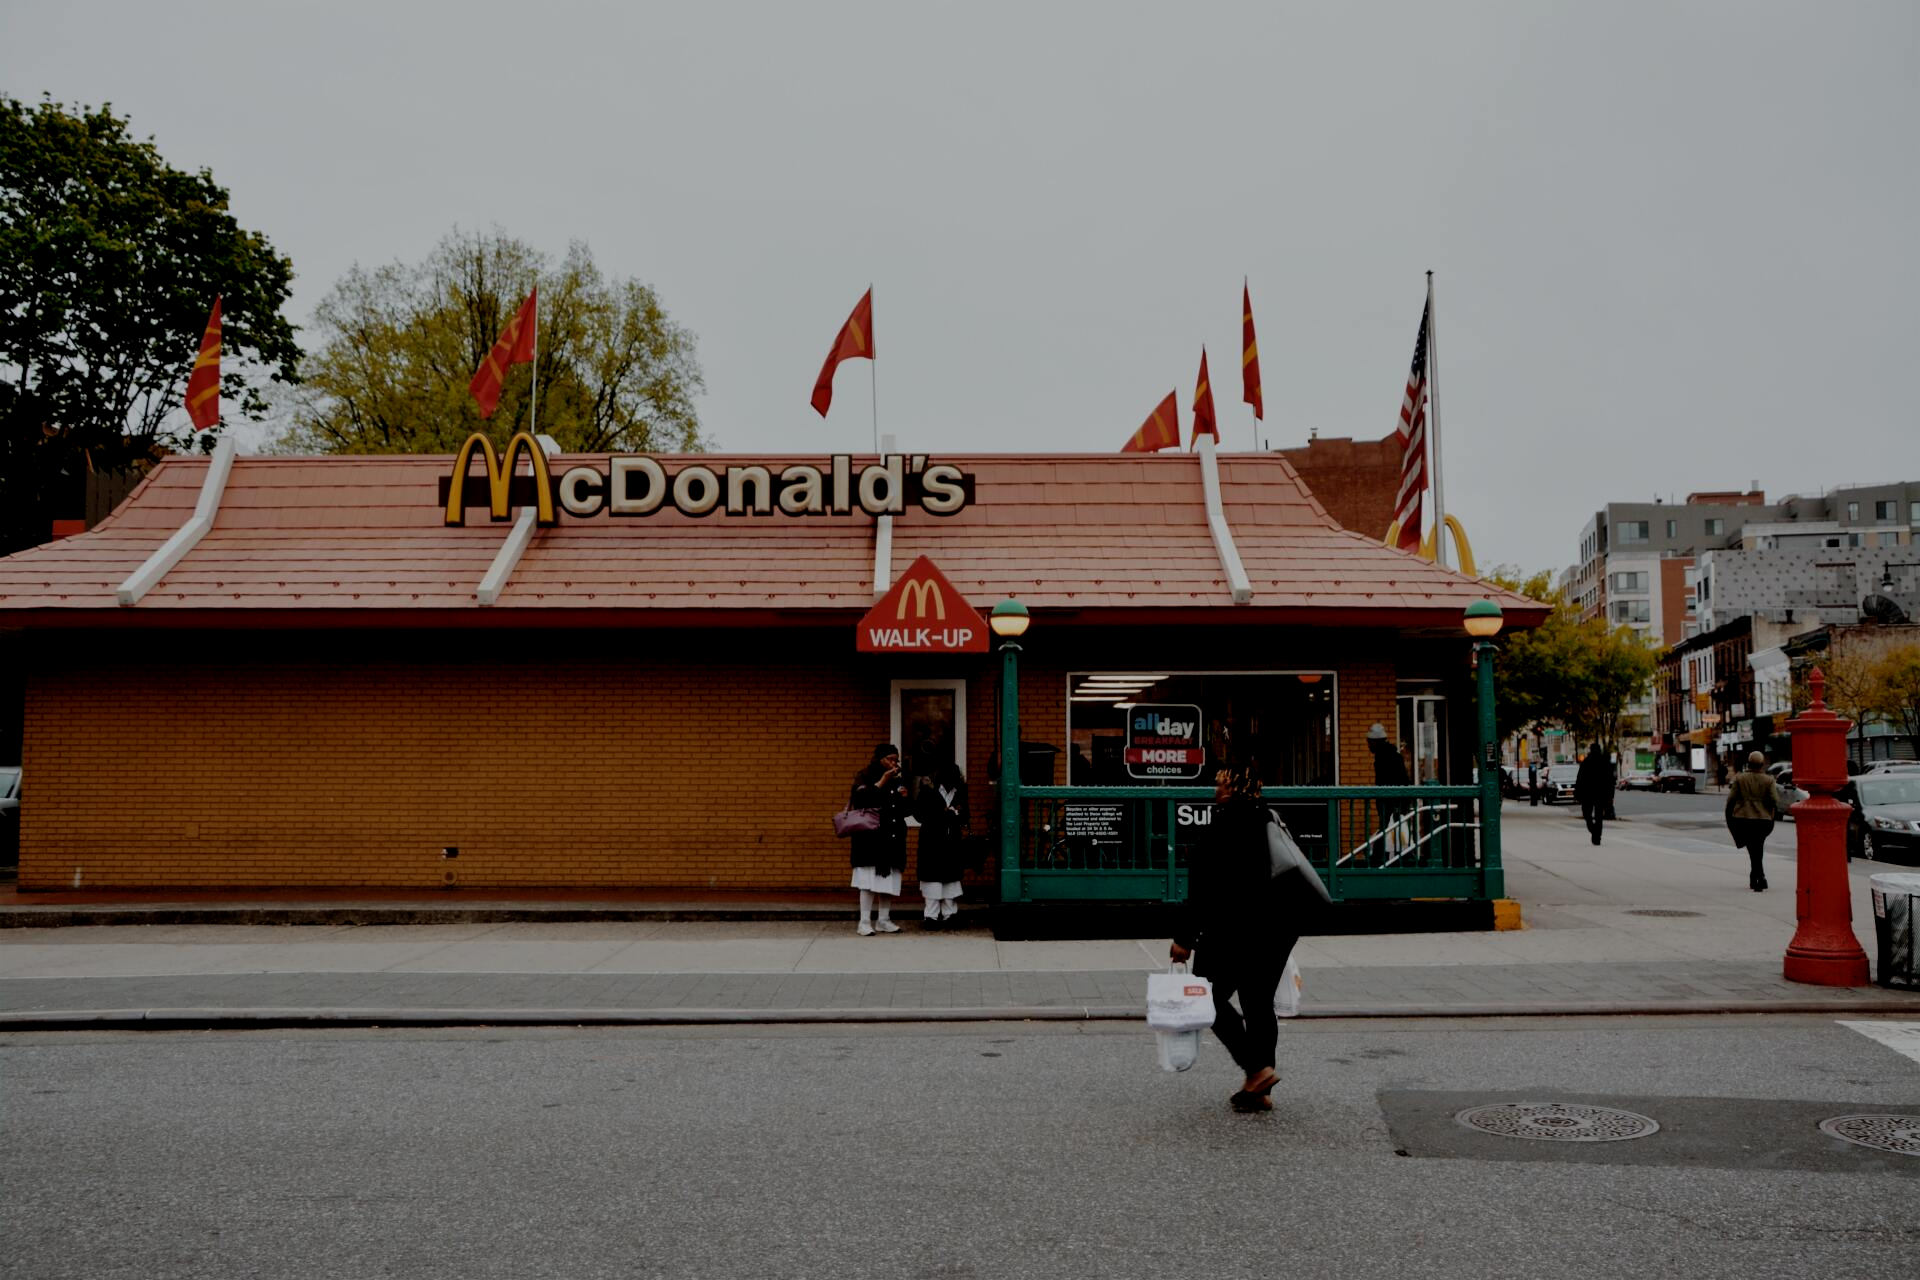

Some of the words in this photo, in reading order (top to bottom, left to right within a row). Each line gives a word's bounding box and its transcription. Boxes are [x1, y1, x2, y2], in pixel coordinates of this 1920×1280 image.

[445, 431, 967, 528] McDonald's
[869, 627, 973, 648] WALK-UP
[1134, 712, 1160, 731] all
[1157, 716, 1194, 739] day
[1141, 748, 1187, 763] MORE
[1146, 764, 1182, 774] choices
